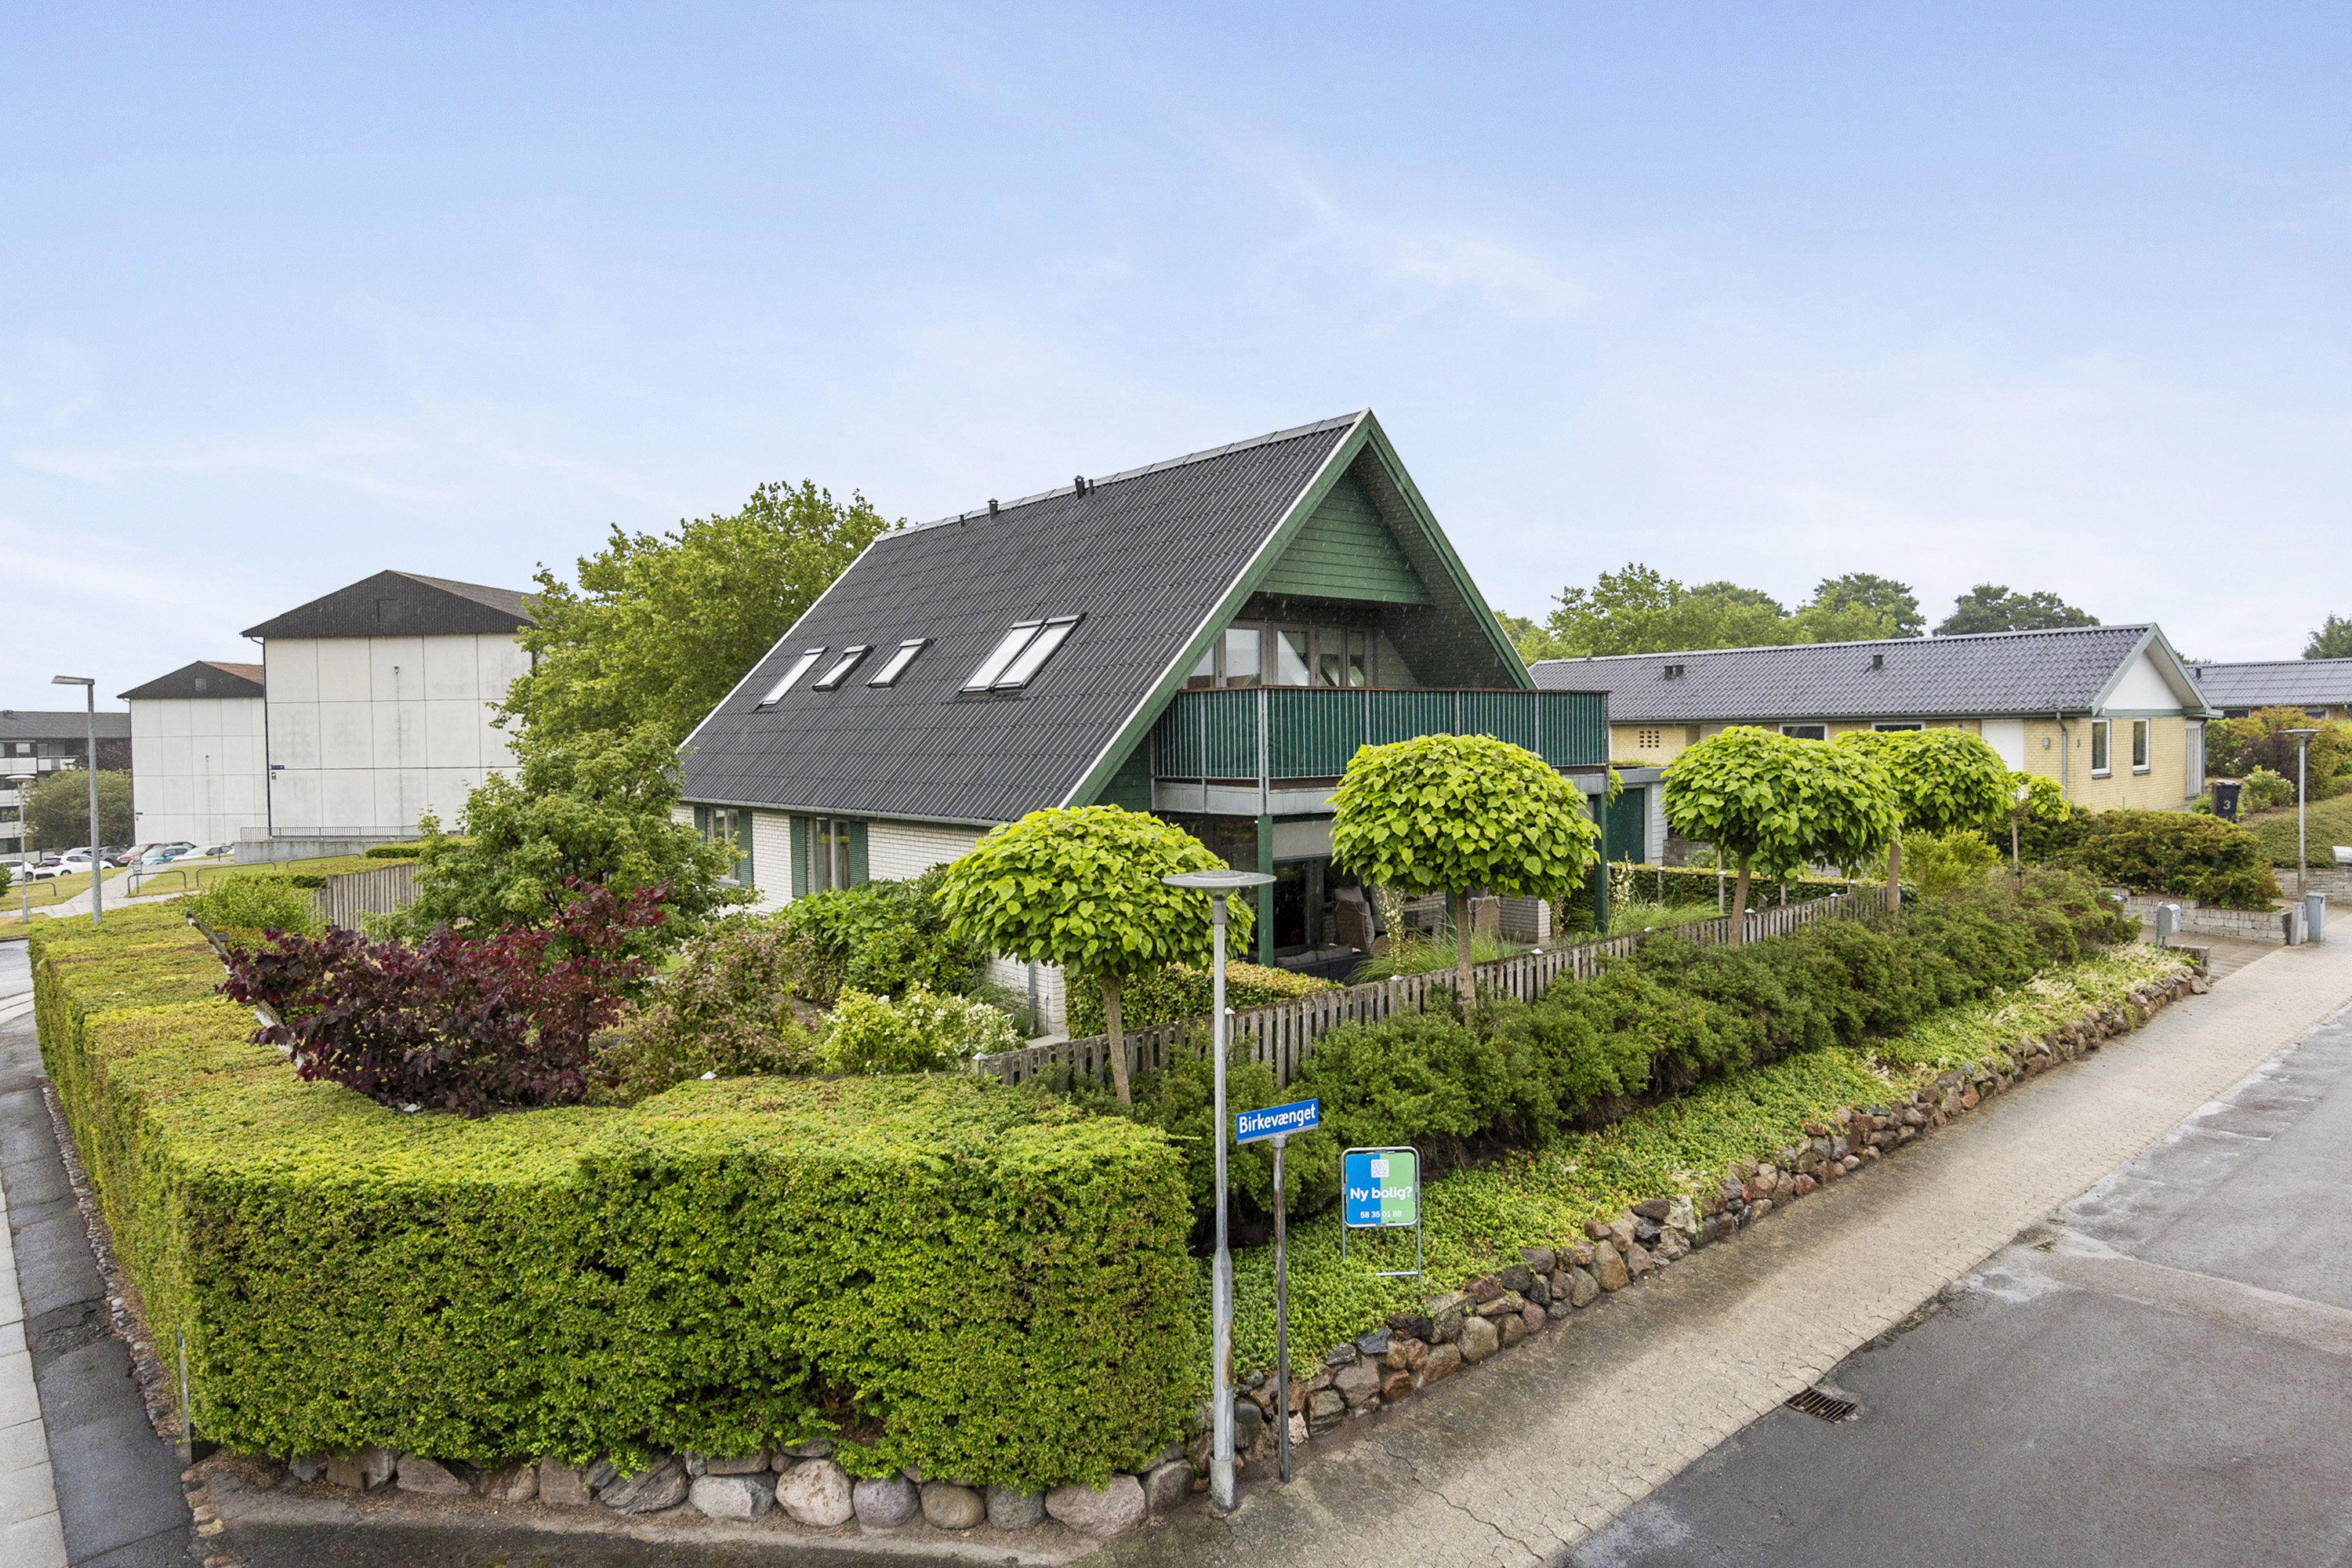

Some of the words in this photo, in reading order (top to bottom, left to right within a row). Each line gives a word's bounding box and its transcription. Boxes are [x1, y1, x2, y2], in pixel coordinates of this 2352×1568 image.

[2223, 800, 2230, 810] 3
[1240, 1103, 1316, 1134] Birkevænget
[1350, 1188, 1369, 1202] Ny
[1371, 1186, 1413, 1200] bolig?
